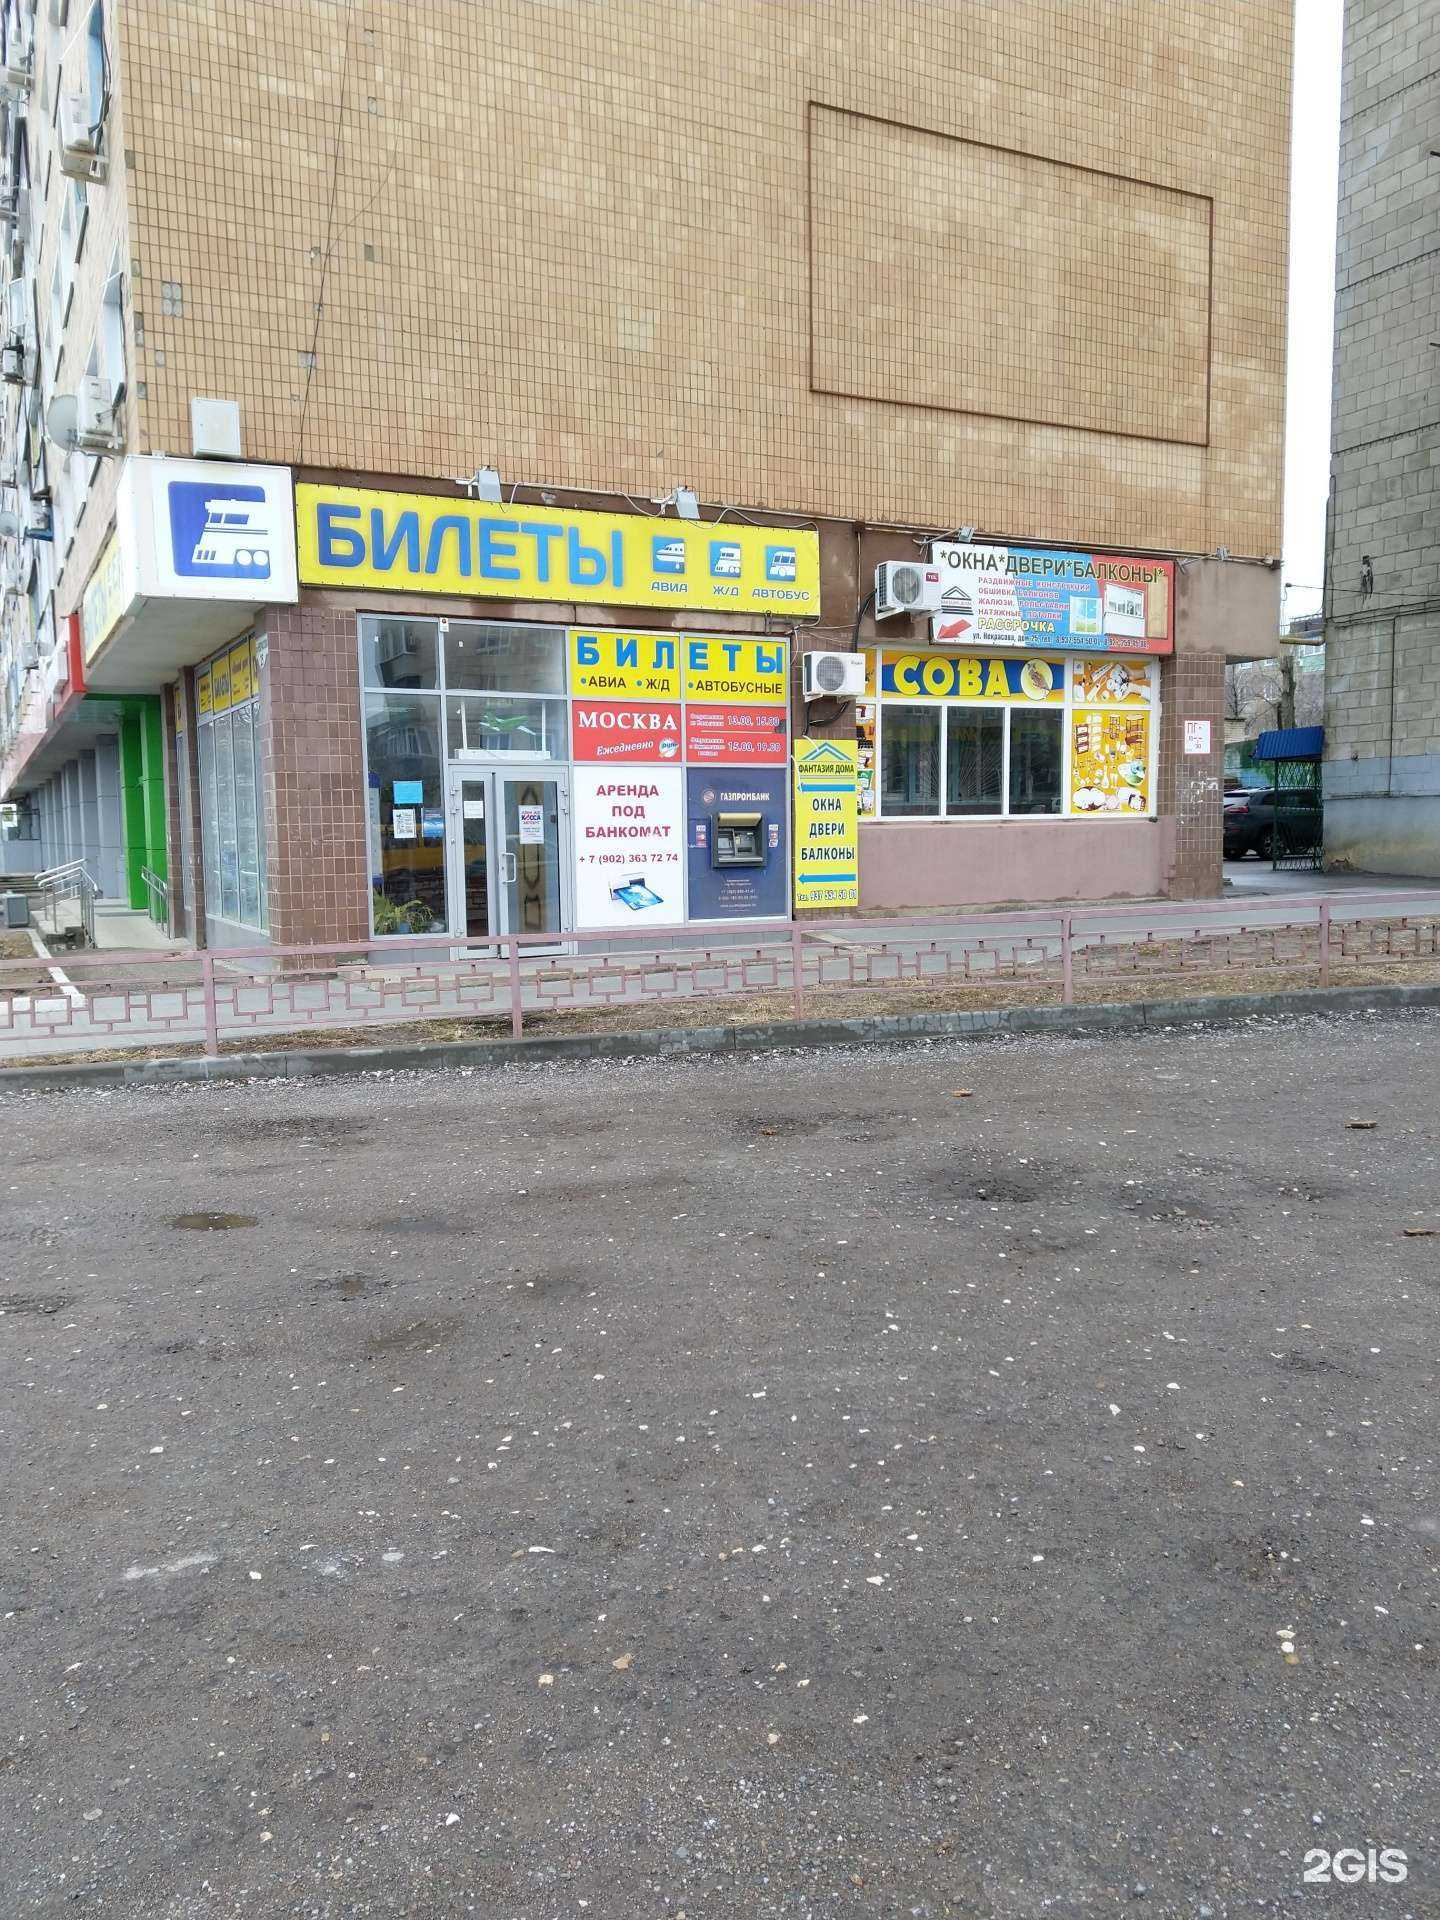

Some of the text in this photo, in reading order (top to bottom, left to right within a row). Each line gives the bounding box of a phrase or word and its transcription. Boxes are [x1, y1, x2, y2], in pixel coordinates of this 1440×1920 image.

[316, 502, 623, 588] БИЛЕТЫ
[651, 581, 688, 593] АВИА
[978, 576, 1033, 587] РАЗДВИЖНЫЕ
[713, 585, 739, 597] Ж/Д
[752, 588, 810, 600] АВТОБУС
[978, 587, 1016, 597] ОБШИВКА
[978, 609, 1022, 617] НАТЯЖНЫЕ
[977, 617, 1056, 633] РАССРОЧКА
[576, 636, 784, 674] БИЛЕТЫ
[588, 676, 627, 689] АВИА
[893, 655, 1011, 697] СОВА
[645, 678, 670, 692] Ж/Д
[695, 680, 783, 694] АВТОБУСНЫЕ
[578, 711, 678, 731] МОСКВА
[596, 740, 654, 756] Ежедневно
[798, 764, 855, 774] ФАНТАЗИЯ ДОМА
[596, 784, 660, 798] АРЕНДА
[720, 792, 770, 801] ГАЗПРОМБАНК
[812, 798, 842, 811] ОКНА
[611, 805, 646, 819] ПОД
[585, 826, 671, 838] БАНКОМАТ
[809, 823, 845, 838] ДВЕРИ
[599, 855, 625, 864] (902)
[629, 854, 647, 863] 363
[651, 854, 663, 862] 72
[666, 853, 678, 861] 74
[801, 847, 855, 860] БАЛКОНЫ
